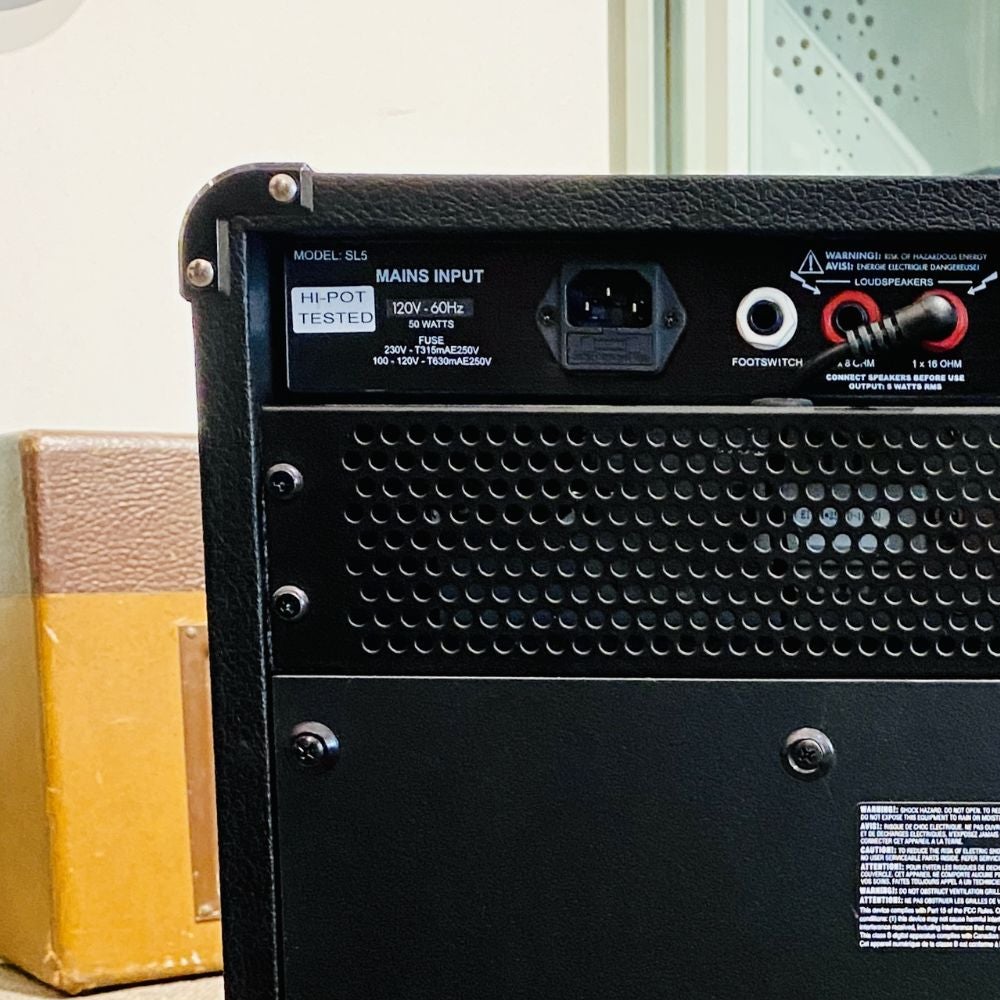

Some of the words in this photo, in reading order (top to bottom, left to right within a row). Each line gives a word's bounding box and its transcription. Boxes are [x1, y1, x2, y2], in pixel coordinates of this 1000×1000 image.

[294, 250, 342, 260] MODEL:
[345, 250, 368, 260] SL5
[958, 253, 987, 261] ENERGY
[376, 269, 429, 283] MAINS
[434, 269, 484, 283] INPUT
[854, 278, 934, 286] LOUDSPEAKERS
[300, 291, 366, 304] HI-POT
[392, 301, 422, 314] 120V
[430, 301, 464, 314] 60Hz
[298, 312, 374, 324] TESTED
[408, 320, 420, 328] 50
[422, 320, 454, 328] WATTS
[418, 336, 444, 344] FUSE
[384, 346, 408, 354] 230V
[373, 357, 389, 366] 100
[397, 357, 420, 366] 120V
[732, 358, 804, 368] FOOTSWITCH
[844, 359, 850, 368] 8
[912, 360, 917, 368] 1
[928, 360, 938, 368] 16
[940, 360, 962, 368] OHM
[826, 374, 866, 382] CONNECT
[868, 374, 912, 382] SPEAKERS
[913, 374, 946, 382] BEFORE
[948, 374, 965, 382] USE
